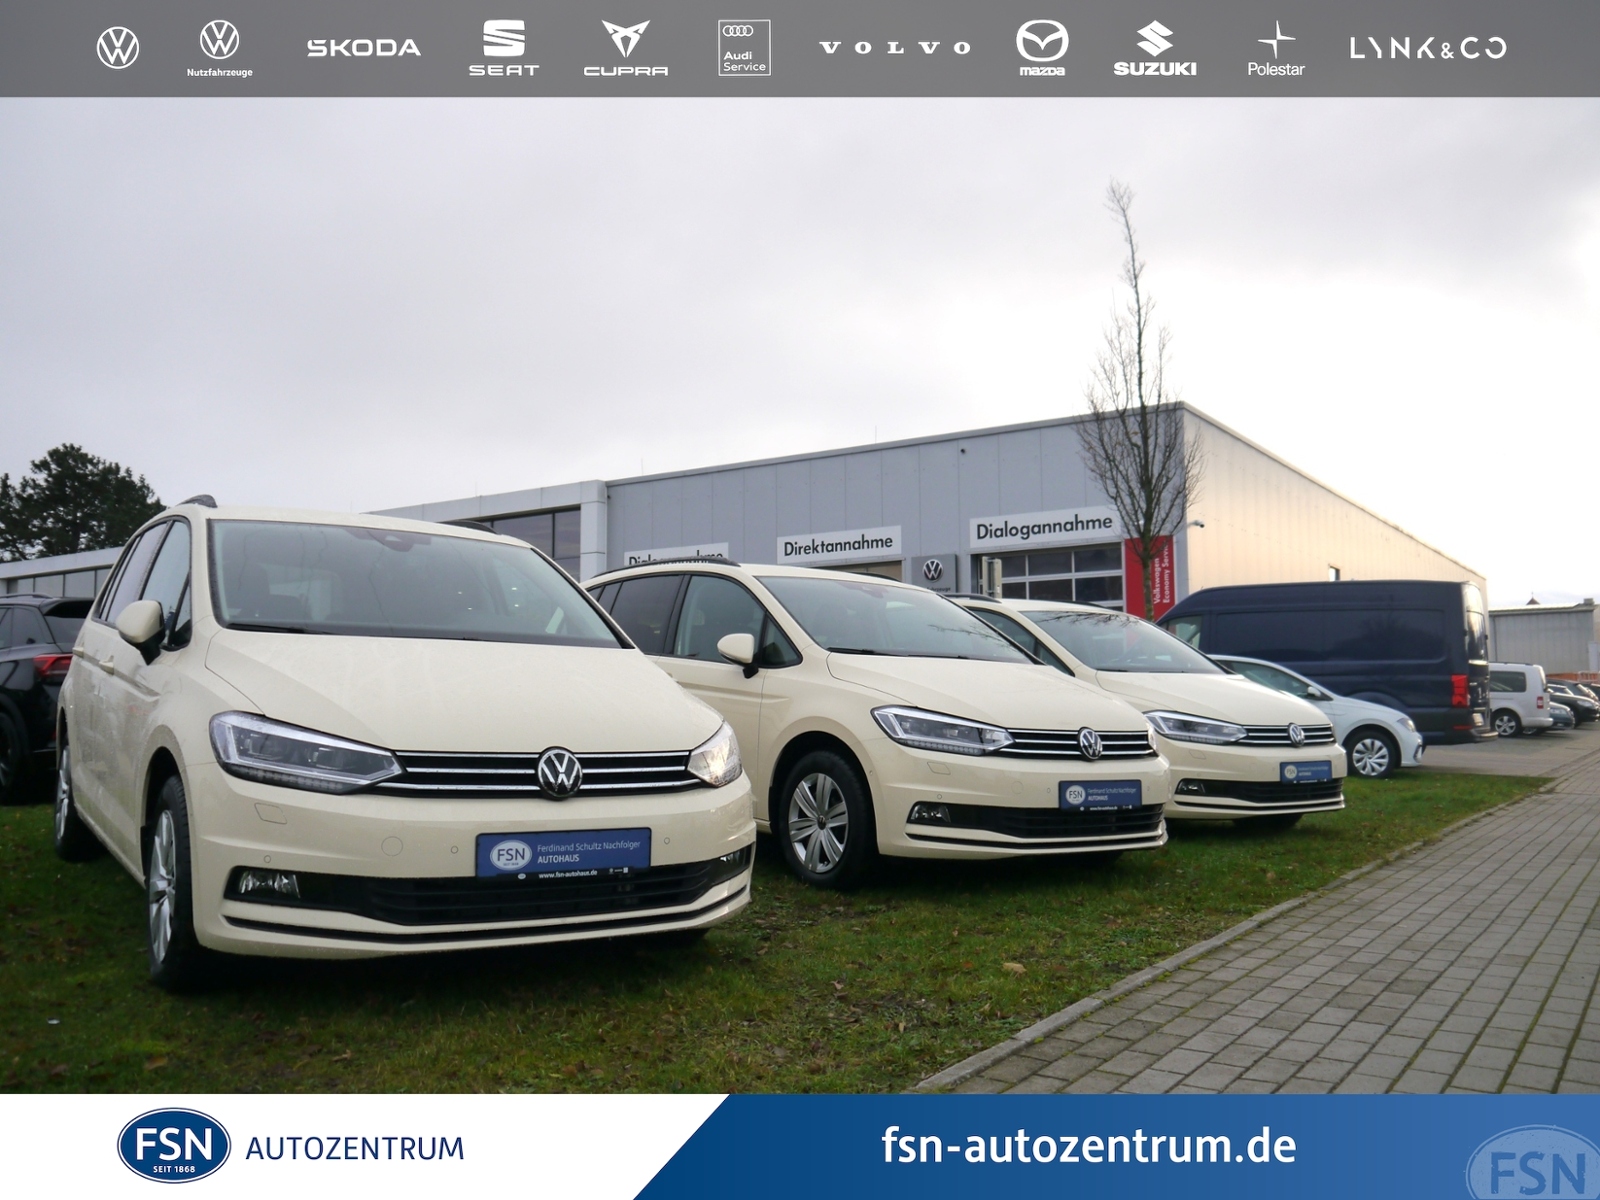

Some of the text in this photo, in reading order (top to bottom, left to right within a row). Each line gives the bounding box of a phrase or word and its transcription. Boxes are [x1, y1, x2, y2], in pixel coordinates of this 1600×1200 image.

[976, 513, 1113, 540] Dialogannahme
[784, 534, 893, 557] Direktannahme
[1153, 557, 1162, 604] Volkswagen
[1162, 569, 1171, 603] Economy
[1069, 790, 1083, 799] FSN
[537, 840, 641, 853] Ferdinand Schultz Nachfolger
[497, 847, 526, 862] FSN
[537, 854, 580, 864] AUTOHAUS
[538, 869, 598, 879] www.fsn-autohaus.de
